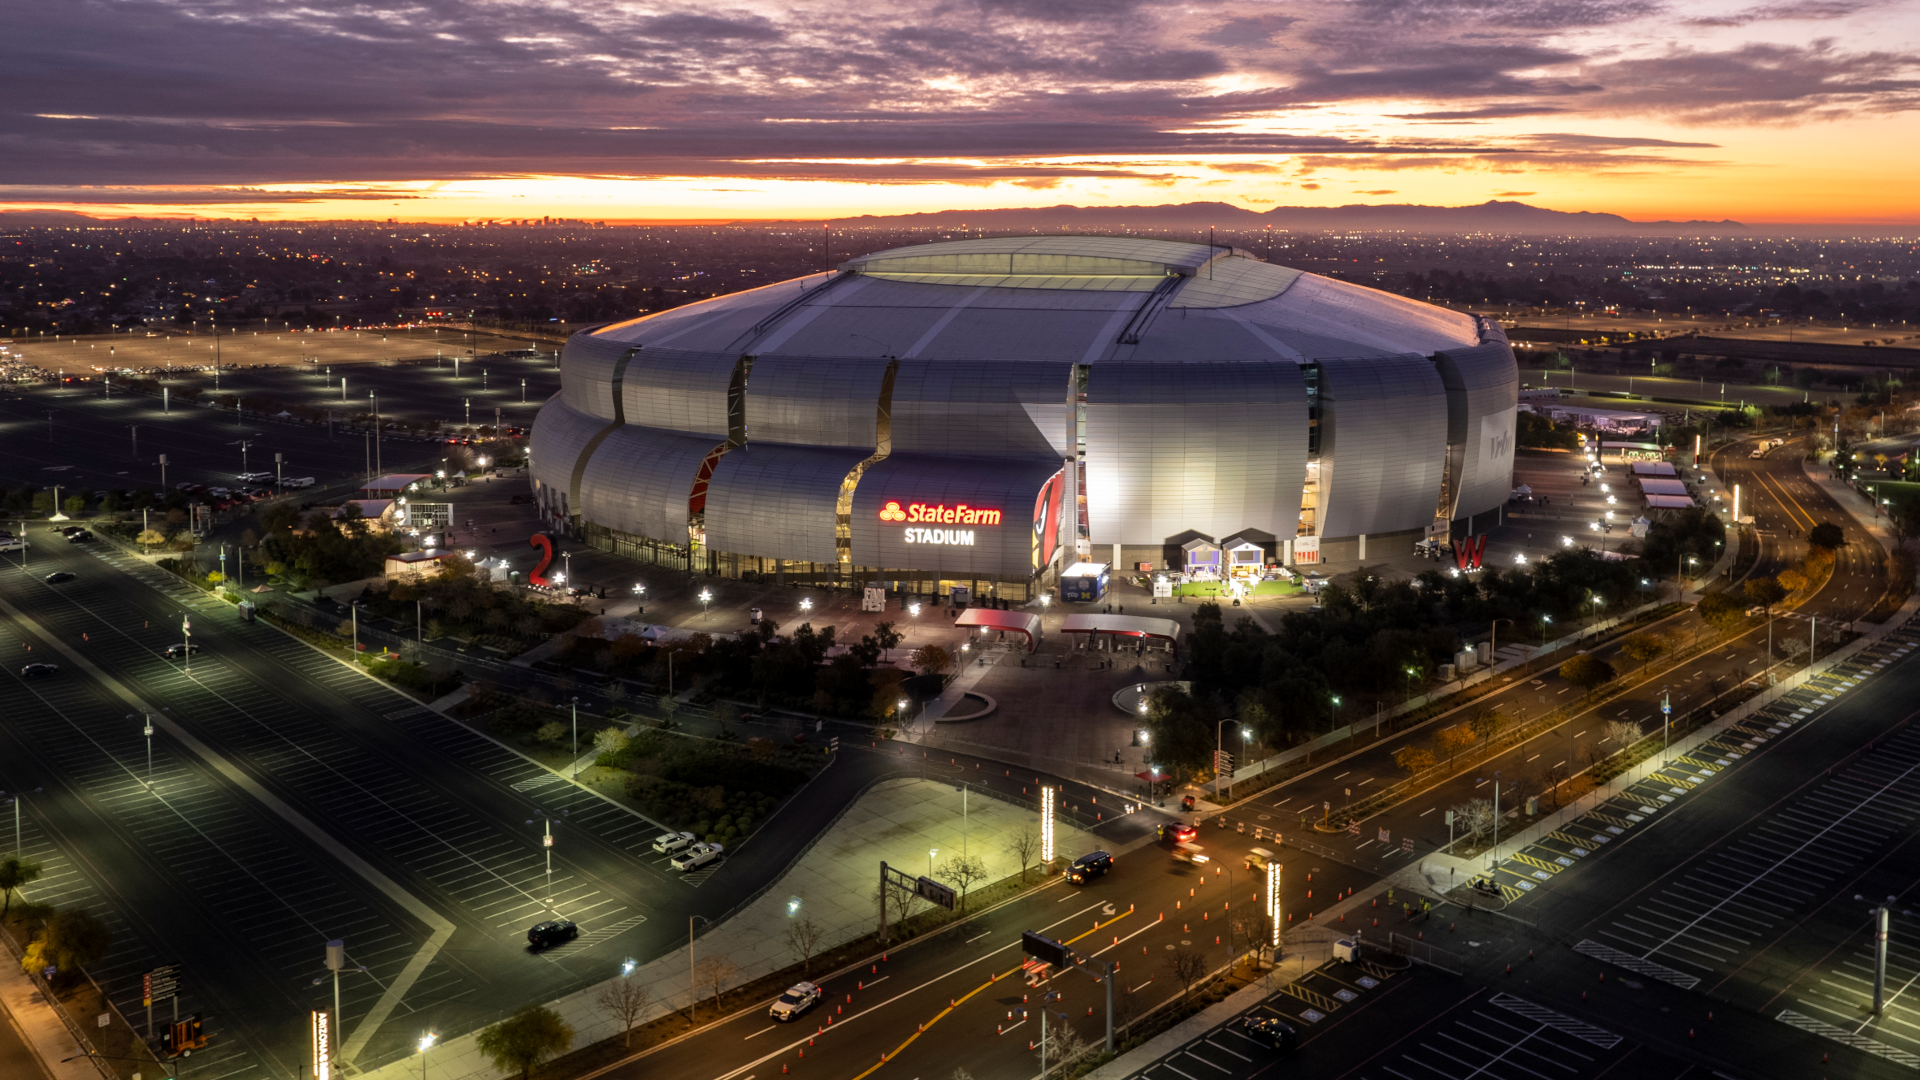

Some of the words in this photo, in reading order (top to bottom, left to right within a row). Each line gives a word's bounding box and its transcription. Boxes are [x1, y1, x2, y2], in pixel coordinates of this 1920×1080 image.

[1490, 430, 1513, 460] Vrbo
[907, 503, 1001, 525] StateFarm
[904, 527, 975, 546] STADIUM
[1453, 534, 1487, 570] W
[864, 587, 885, 600] FAN
[862, 599, 886, 612] FEST
